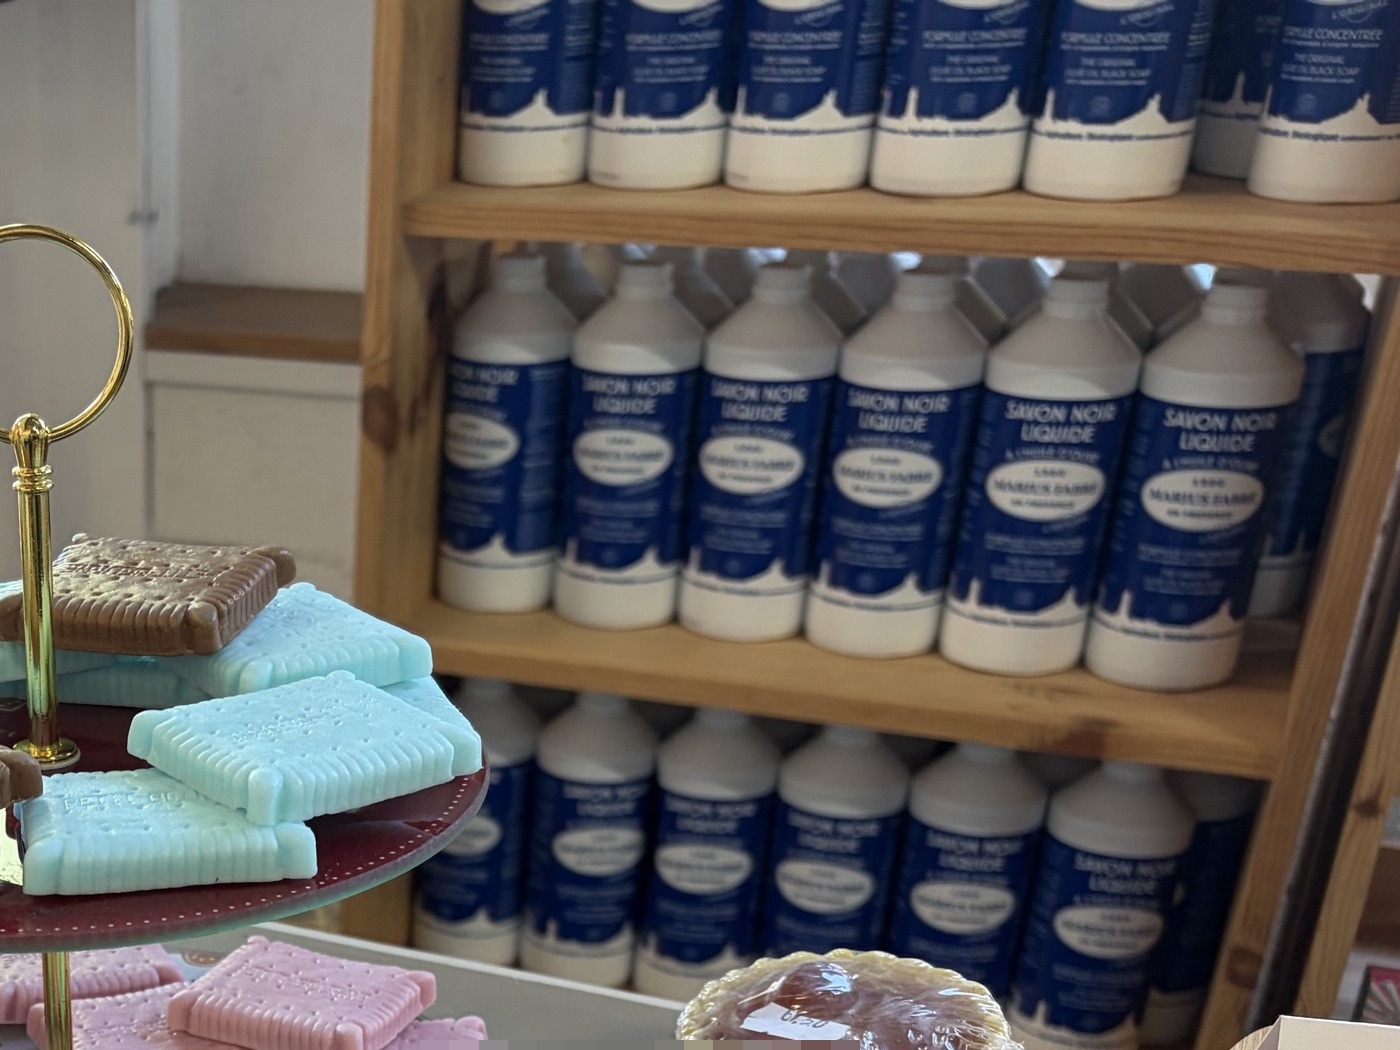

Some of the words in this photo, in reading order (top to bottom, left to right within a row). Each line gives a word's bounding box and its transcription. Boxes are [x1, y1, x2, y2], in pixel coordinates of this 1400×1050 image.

[901, 394, 950, 413] NOIR
[1005, 401, 1068, 424] SAVON
[1069, 403, 1117, 424] NOIR
[1162, 408, 1228, 431] SAVON
[1230, 411, 1277, 432] NOIR
[1020, 423, 1096, 444] LIQUIDE
[1178, 431, 1256, 452] LIQUIDE
